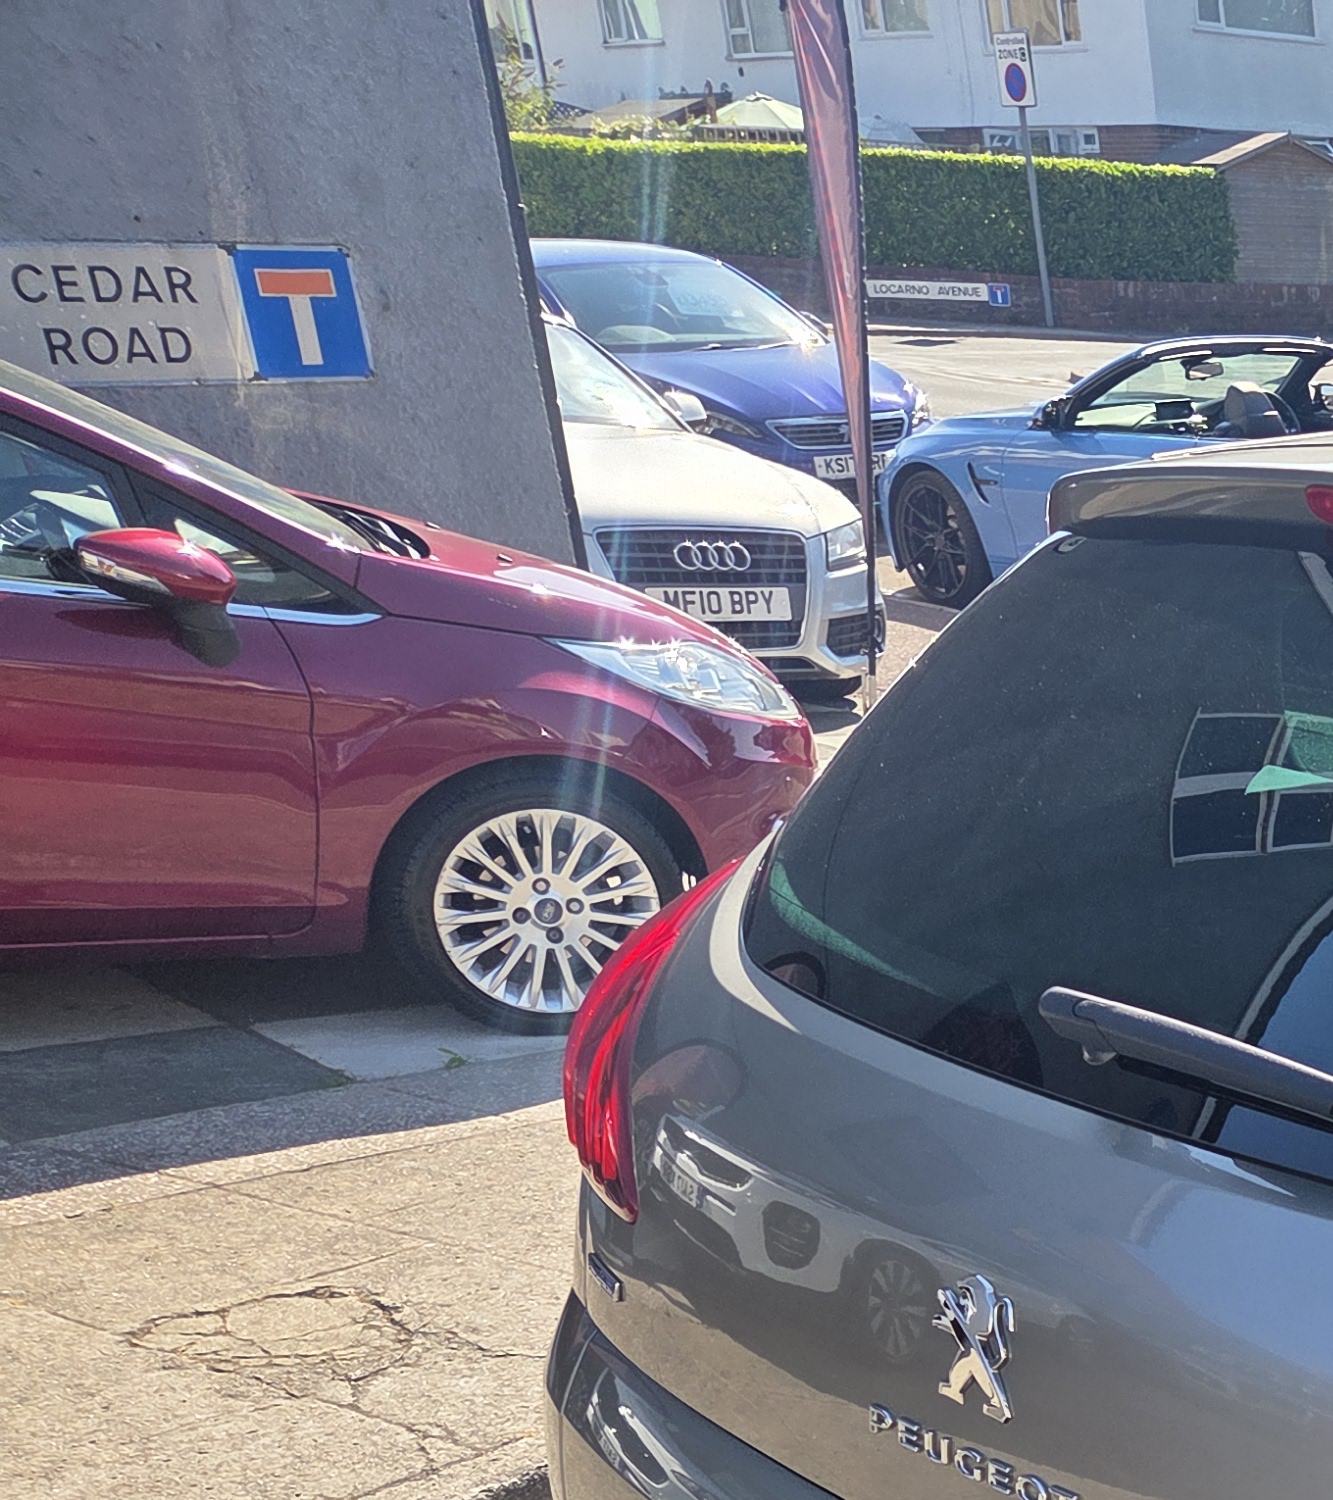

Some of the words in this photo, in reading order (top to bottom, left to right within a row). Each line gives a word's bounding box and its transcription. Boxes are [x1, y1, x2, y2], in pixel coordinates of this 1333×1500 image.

[11, 263, 199, 304] CEDAR
[873, 284, 930, 296] LOCARNO
[937, 286, 982, 297] AVENUE
[43, 326, 193, 366] ROAD
[728, 590, 773, 615] BPY
